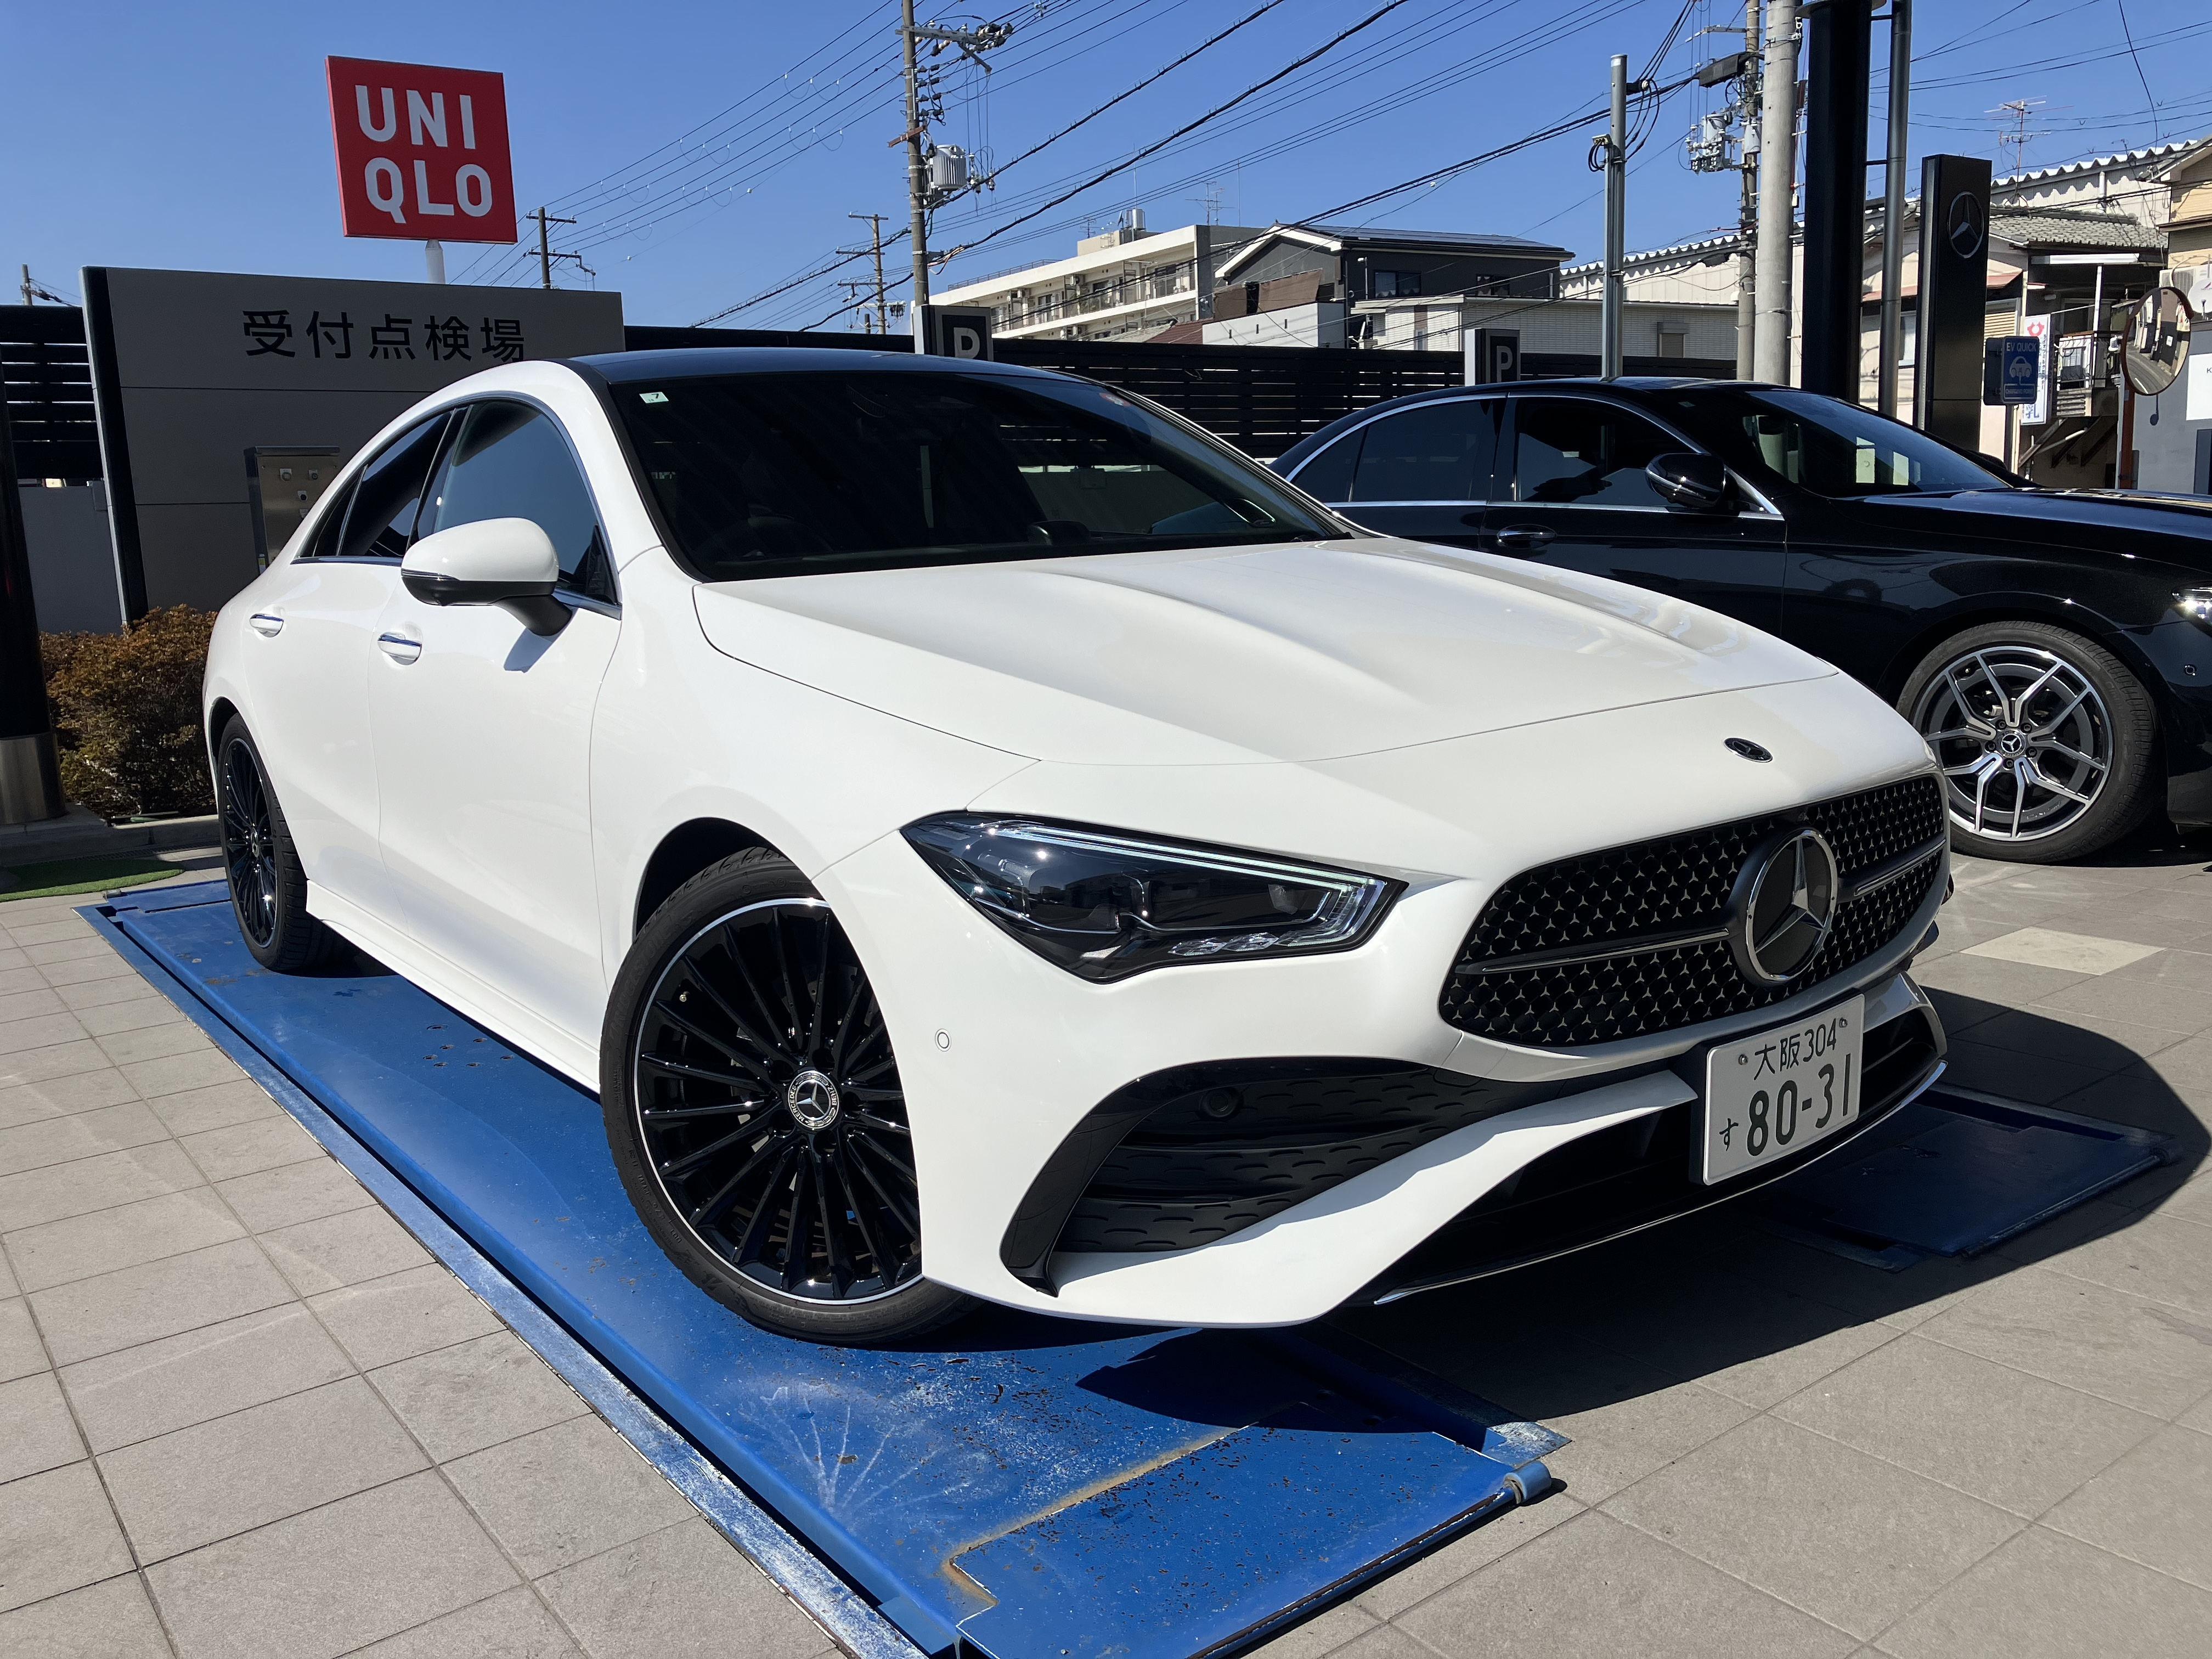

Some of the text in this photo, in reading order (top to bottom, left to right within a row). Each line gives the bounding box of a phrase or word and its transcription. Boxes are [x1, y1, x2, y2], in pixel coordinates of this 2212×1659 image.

[355, 85, 476, 150] UNI
[364, 157, 493, 224] QLO
[242, 309, 524, 363] 受付点検場
[2006, 342, 2036, 352] EV QUICK
[1497, 345, 1513, 383] P
[790, 1085, 837, 1122] MERCEDES BENZ
[1719, 1053, 1851, 1156] す 80-31
